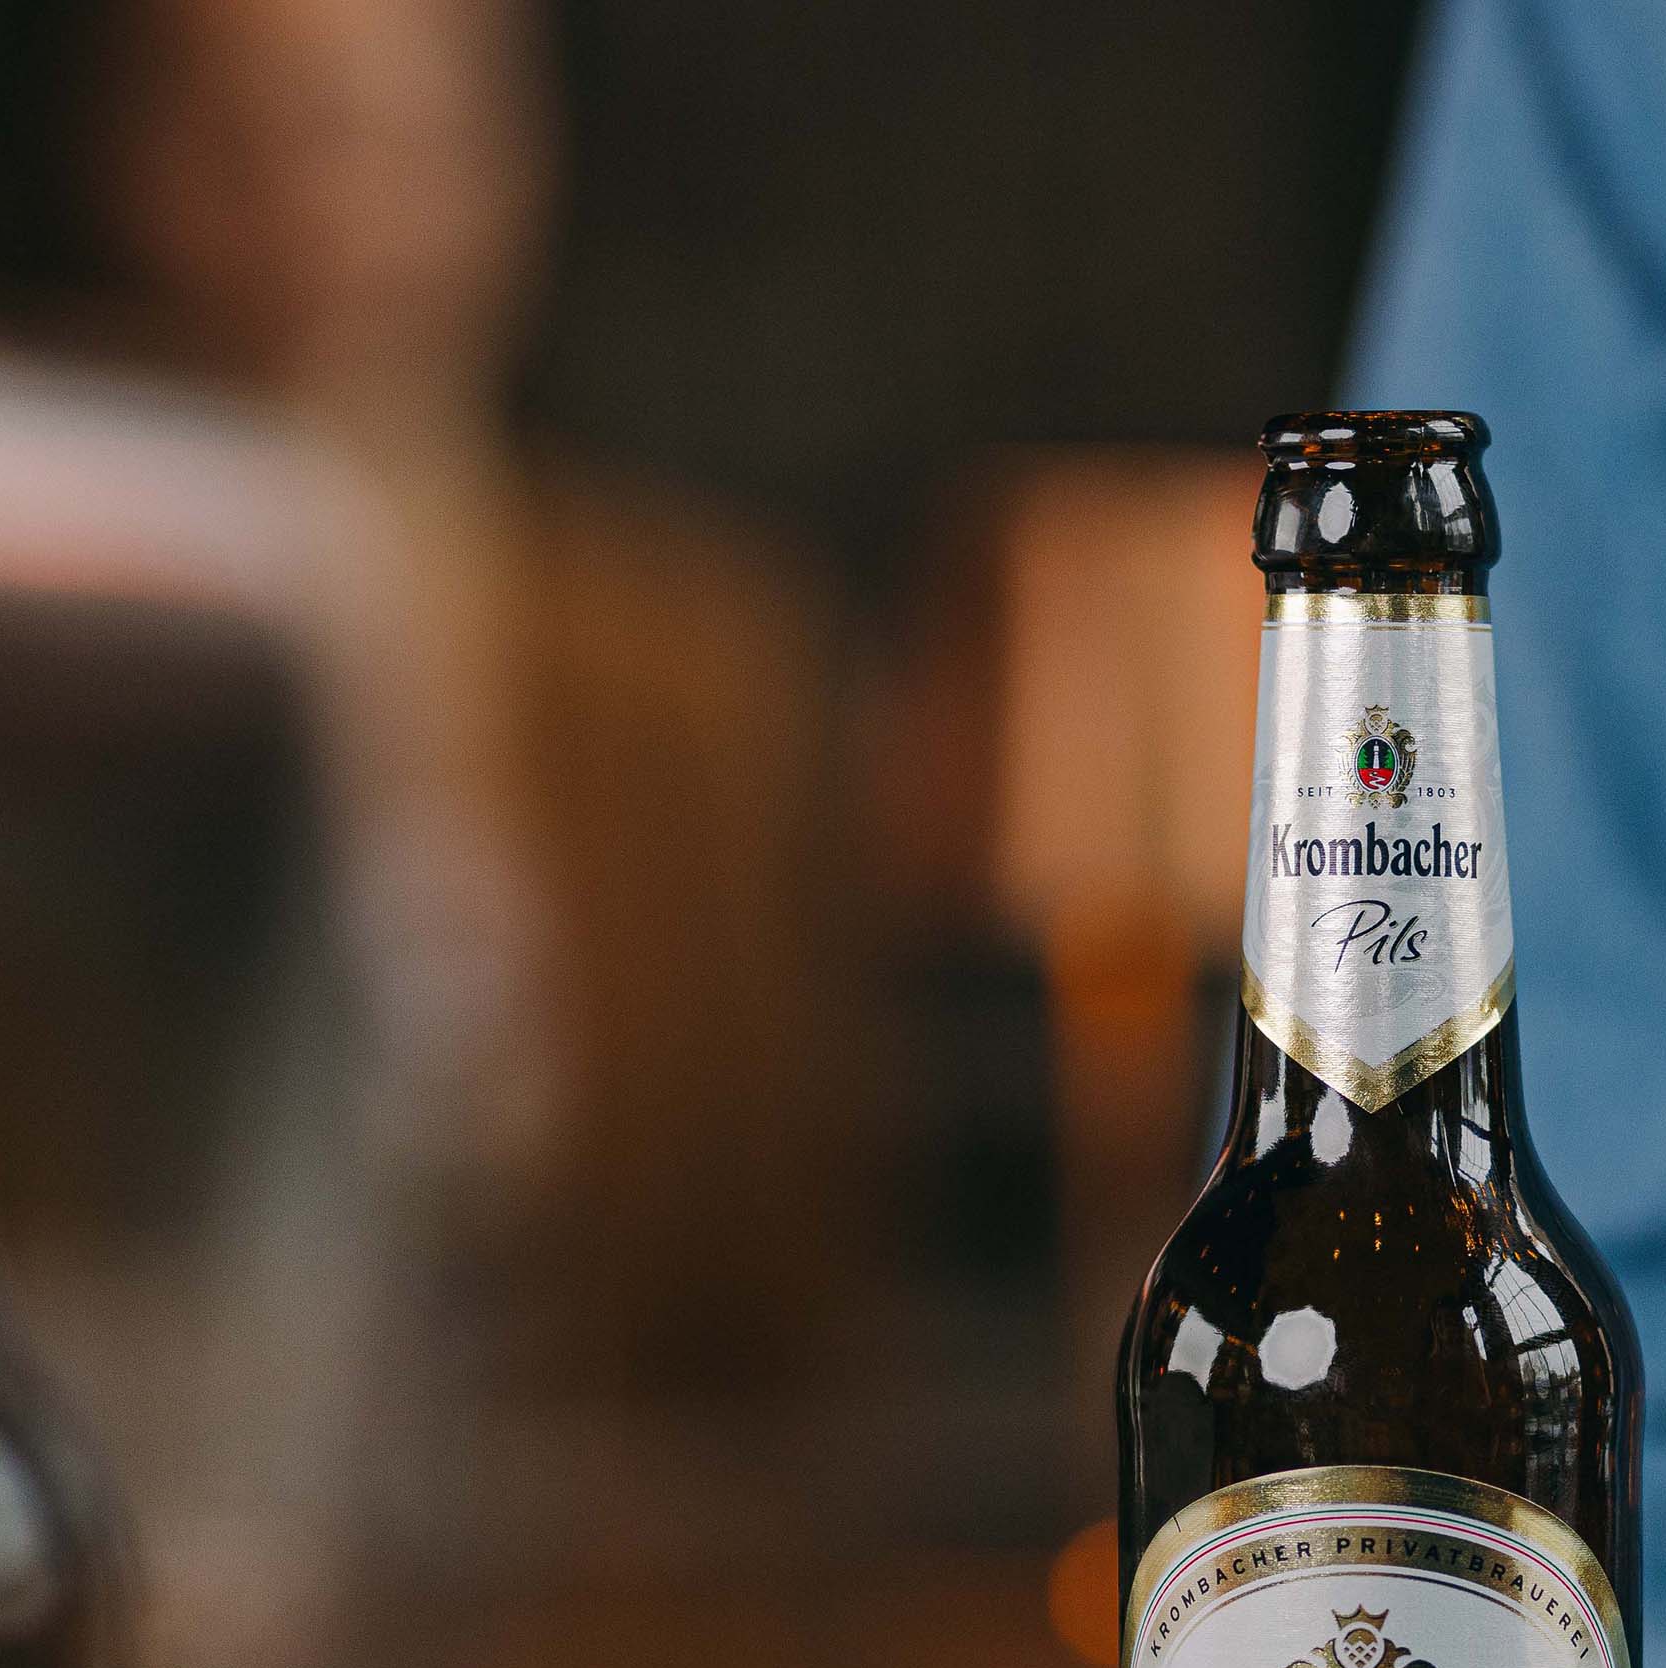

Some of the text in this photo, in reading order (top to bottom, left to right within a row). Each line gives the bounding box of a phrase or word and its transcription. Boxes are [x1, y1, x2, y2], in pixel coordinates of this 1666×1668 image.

[1297, 786, 1456, 798] SEIT 1803
[1270, 821, 1483, 880] Krombacher
[1310, 899, 1429, 974] Pils
[1149, 1536, 1590, 1660] KROMBACHER PRIVATBRAUEREI
